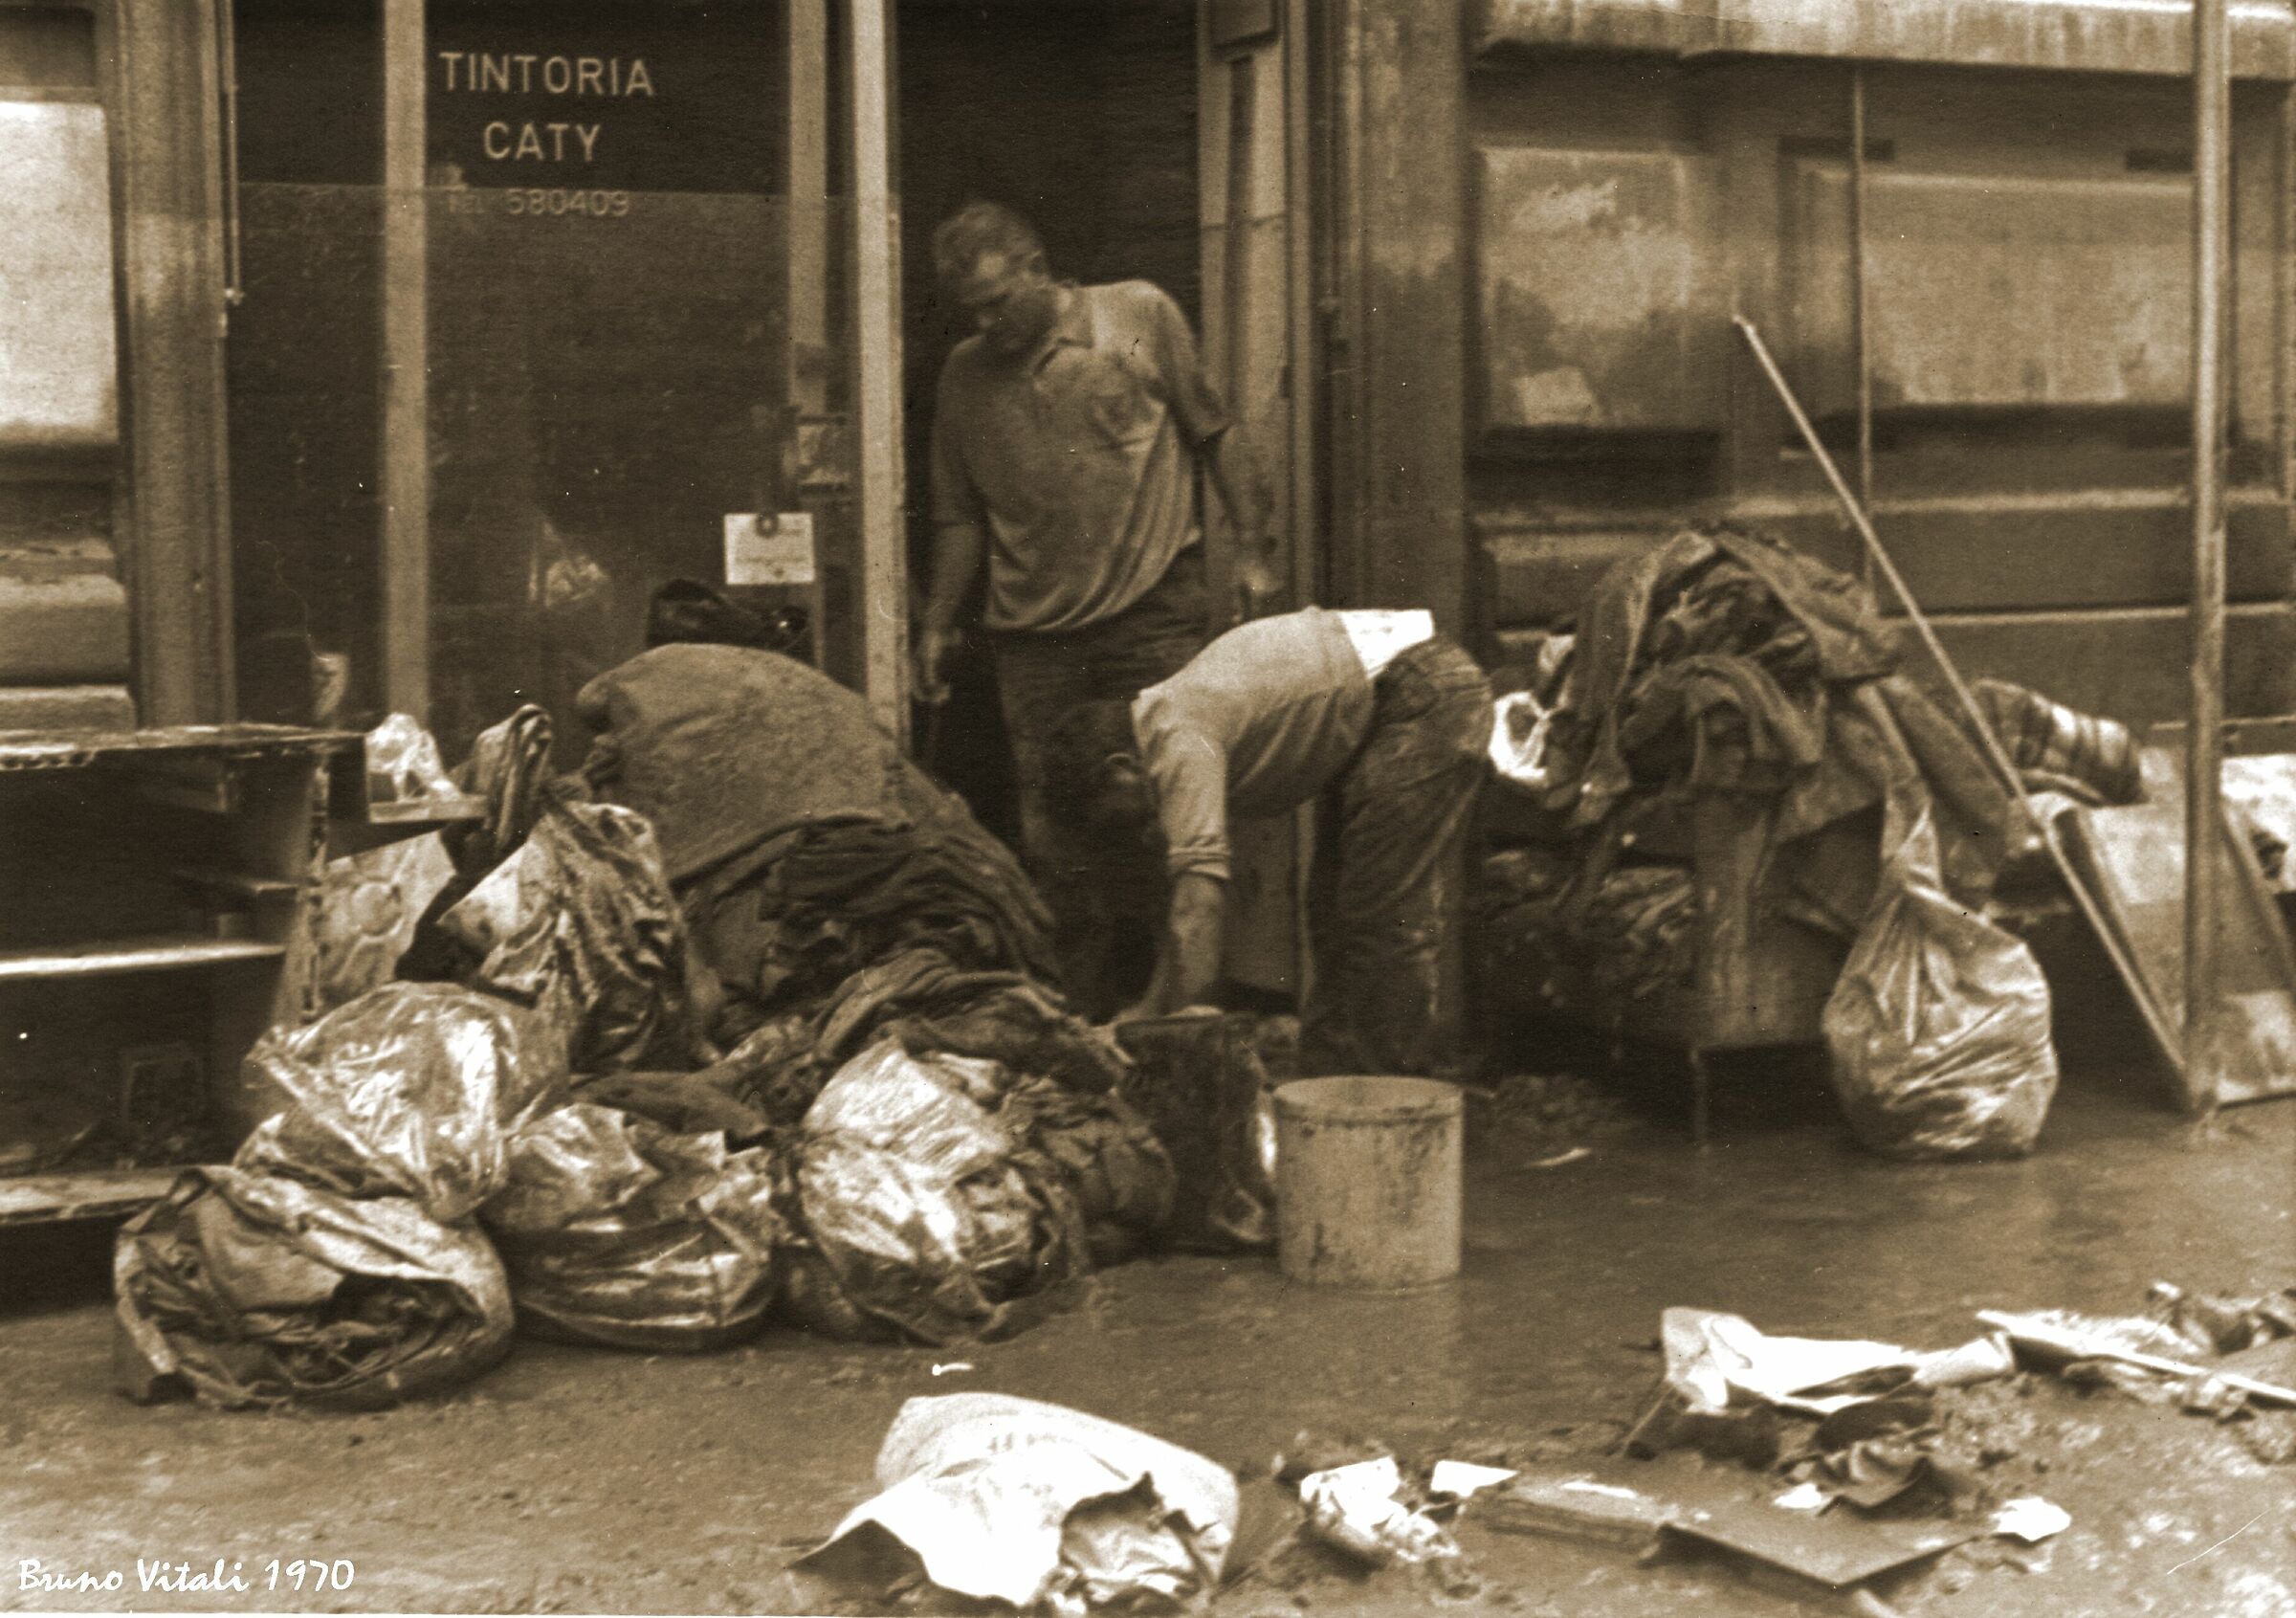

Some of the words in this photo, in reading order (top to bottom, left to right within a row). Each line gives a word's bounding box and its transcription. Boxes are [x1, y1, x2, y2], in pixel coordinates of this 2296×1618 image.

[439, 51, 655, 97] TINTORIA
[483, 121, 601, 163] CATY
[505, 188, 631, 218] 580409
